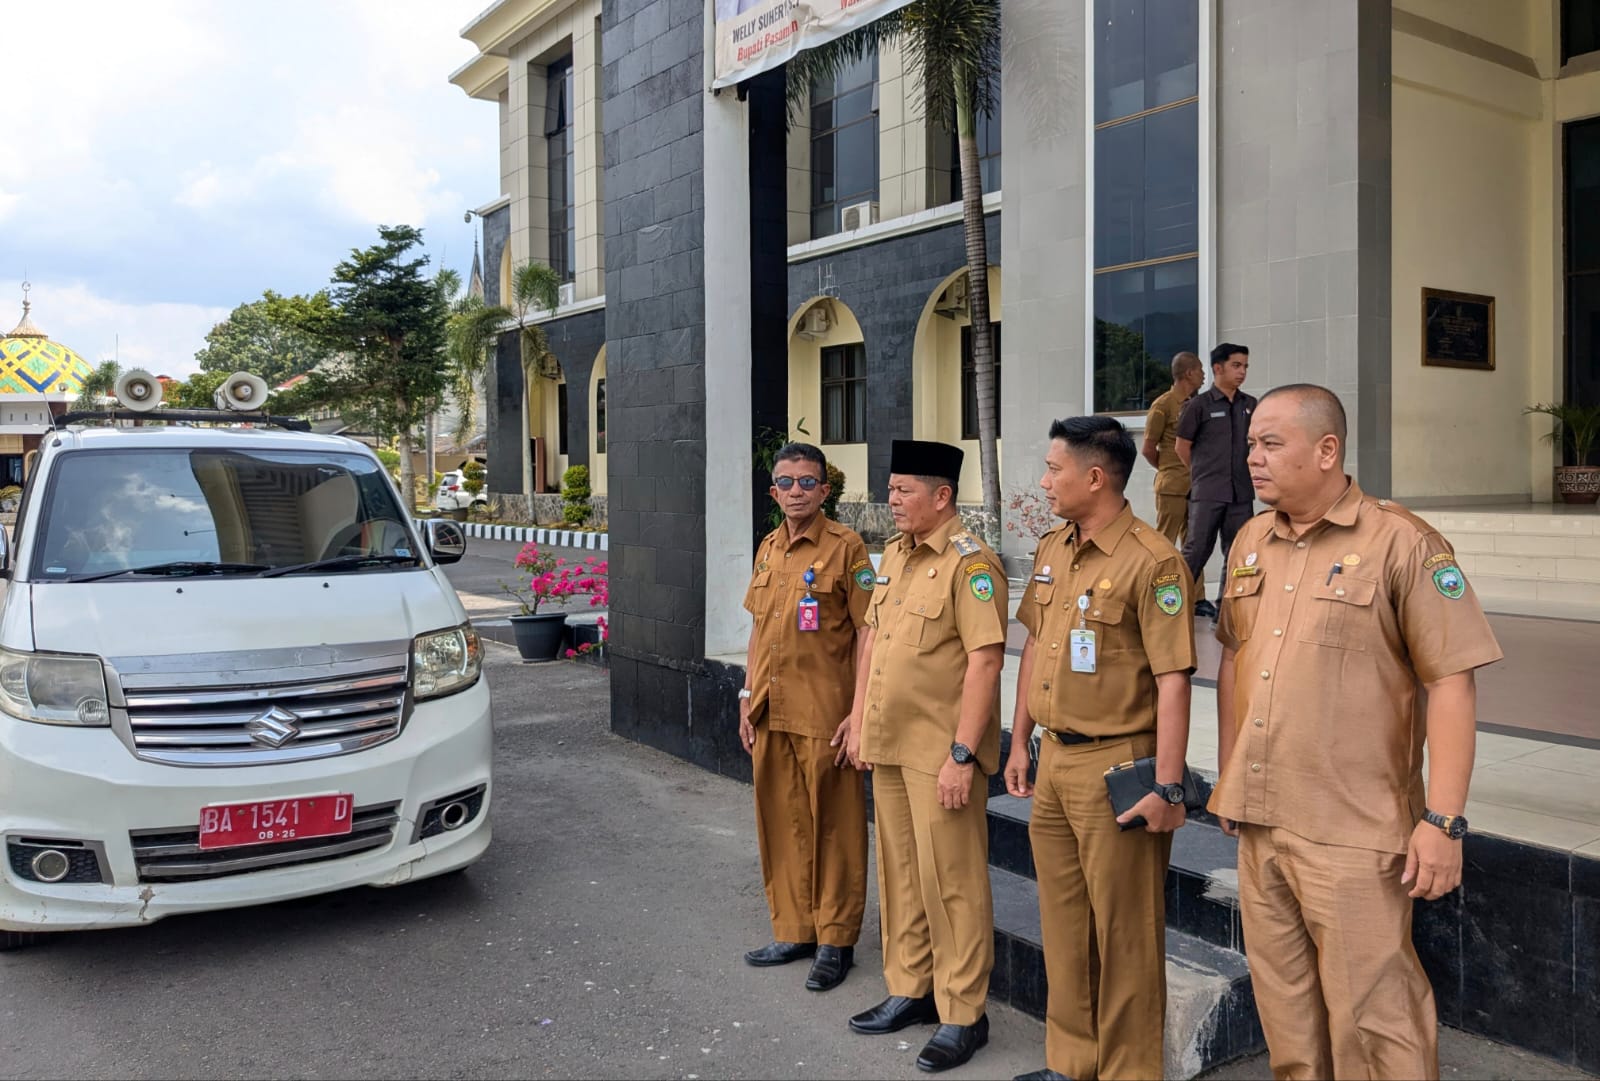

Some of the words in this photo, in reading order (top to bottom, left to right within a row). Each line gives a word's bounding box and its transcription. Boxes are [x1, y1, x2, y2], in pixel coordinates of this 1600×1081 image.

[732, 17, 756, 44] WELLY
[737, 38, 763, 62] Bupati
[204, 807, 233, 833] BA
[251, 800, 300, 830] 1541
[334, 797, 348, 821] D
